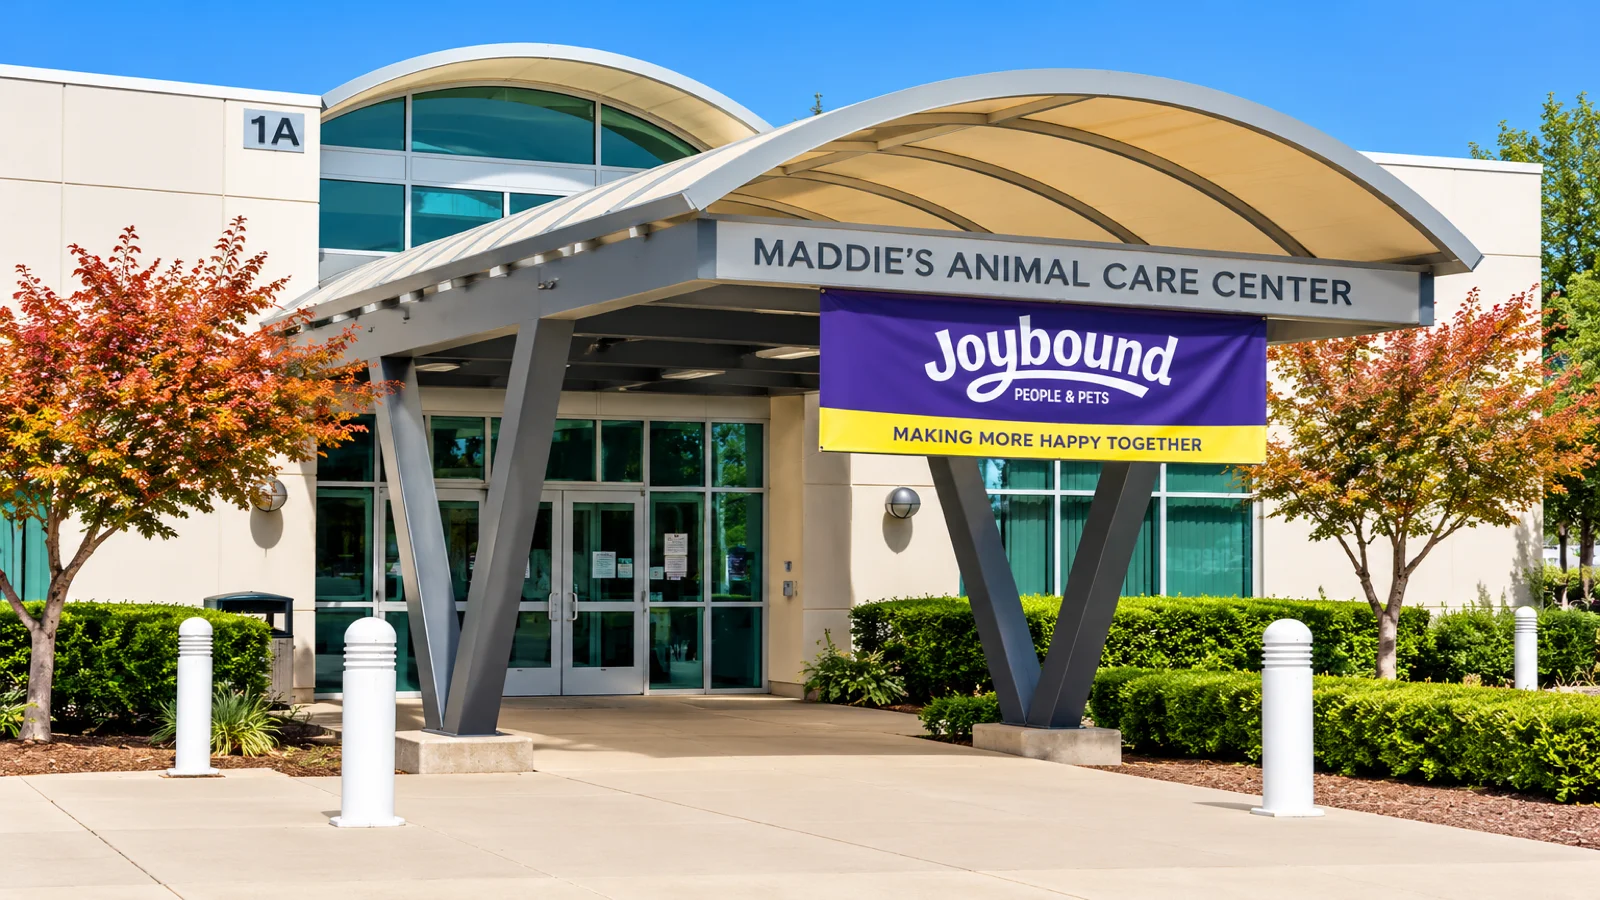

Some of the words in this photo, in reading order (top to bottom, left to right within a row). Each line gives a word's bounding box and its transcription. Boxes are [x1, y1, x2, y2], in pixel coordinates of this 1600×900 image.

[251, 115, 300, 147] 1A
[753, 237, 935, 278] MADDIE'S
[946, 251, 1091, 288] ANIMAL
[1102, 262, 1199, 296] CARE
[1211, 270, 1353, 307] CENTER
[924, 314, 1180, 403] Joybound
[1014, 387, 1062, 403] PEOPLE
[1065, 389, 1076, 404] &
[1078, 390, 1110, 405] PETS
[893, 426, 973, 445] MAKING
[979, 431, 1033, 447] MORE
[1040, 434, 1101, 450] HAPPY
[1106, 436, 1202, 452] TOGETHER
